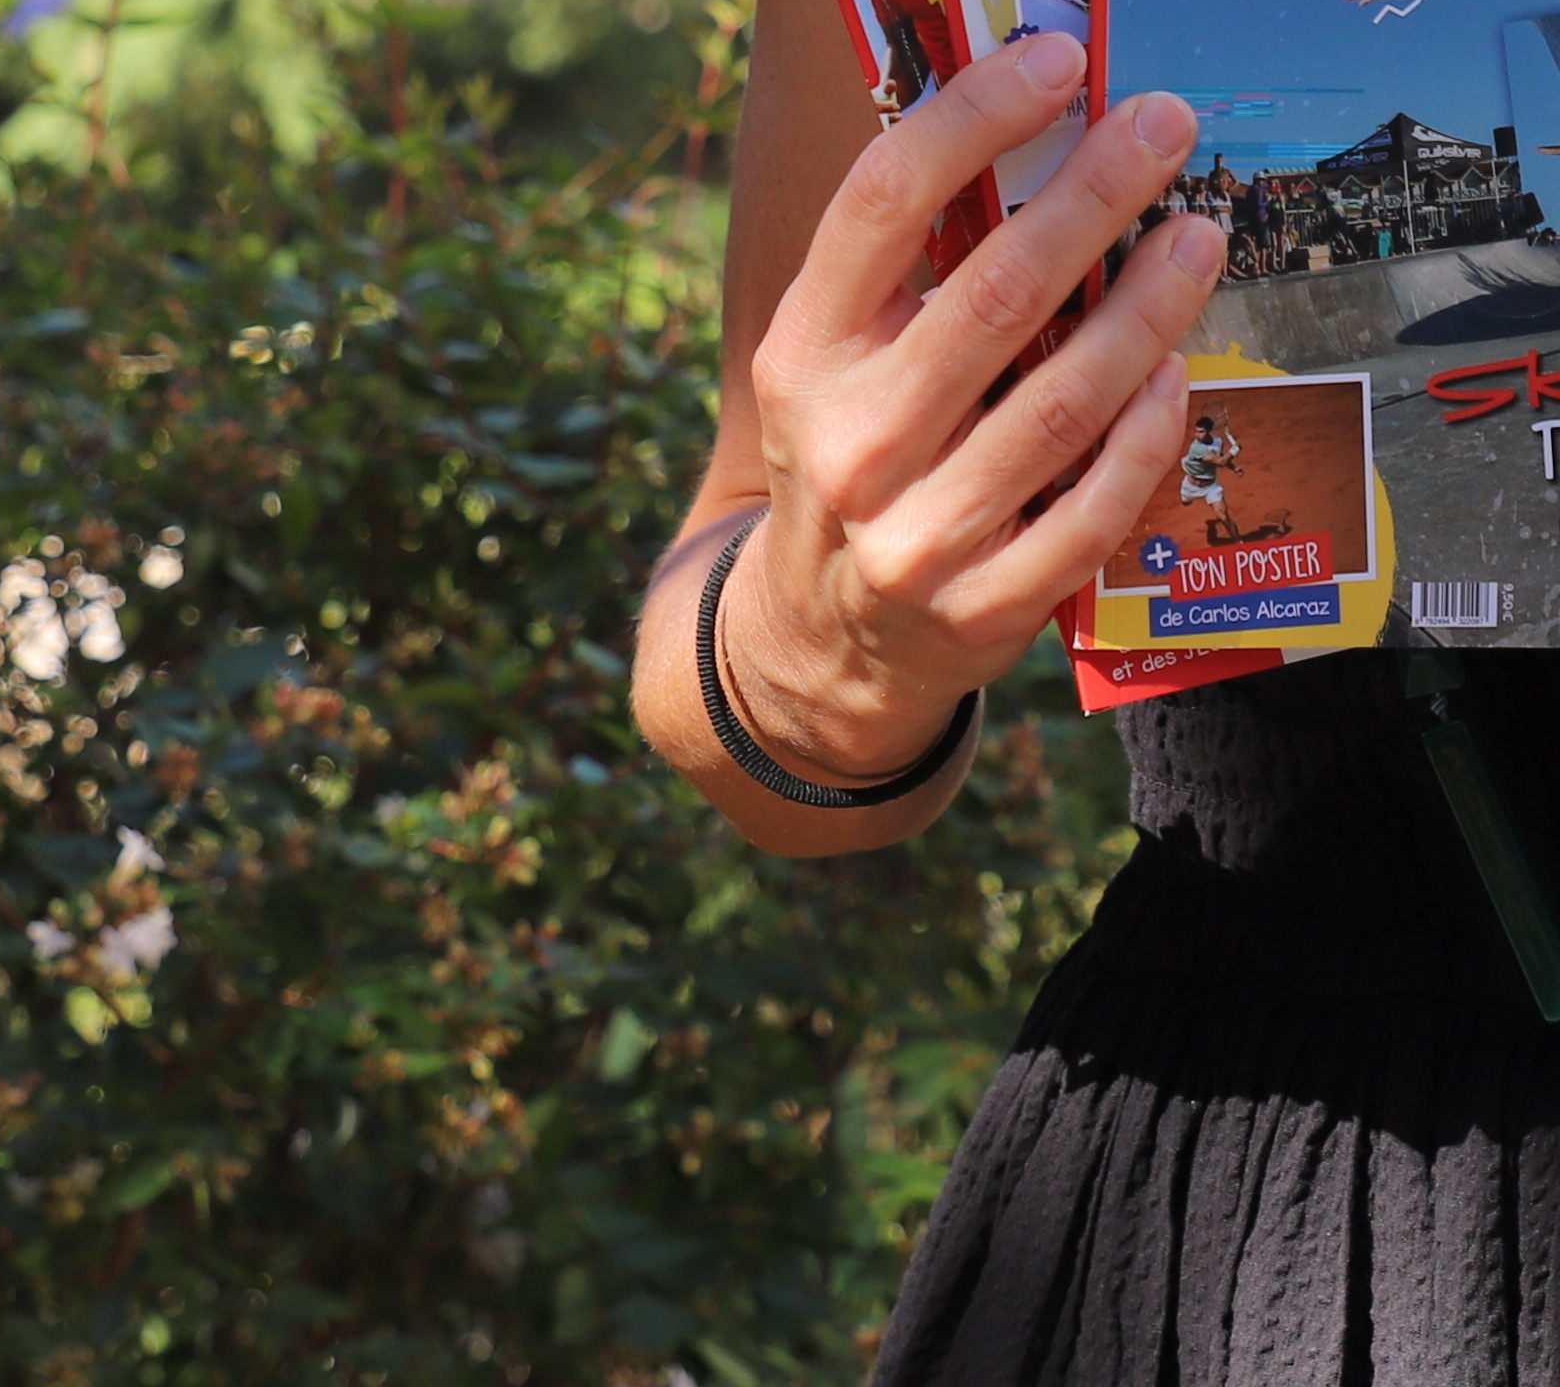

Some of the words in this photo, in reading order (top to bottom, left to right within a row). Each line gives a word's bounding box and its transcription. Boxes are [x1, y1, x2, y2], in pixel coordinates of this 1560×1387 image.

[1175, 555, 1226, 595] TON
[1235, 541, 1321, 587] POSTER
[1159, 607, 1184, 629] de
[1188, 601, 1251, 626] Carlos
[1256, 597, 1331, 621] Alcaraz
[1112, 660, 1135, 682] et
[1142, 651, 1177, 673] des
